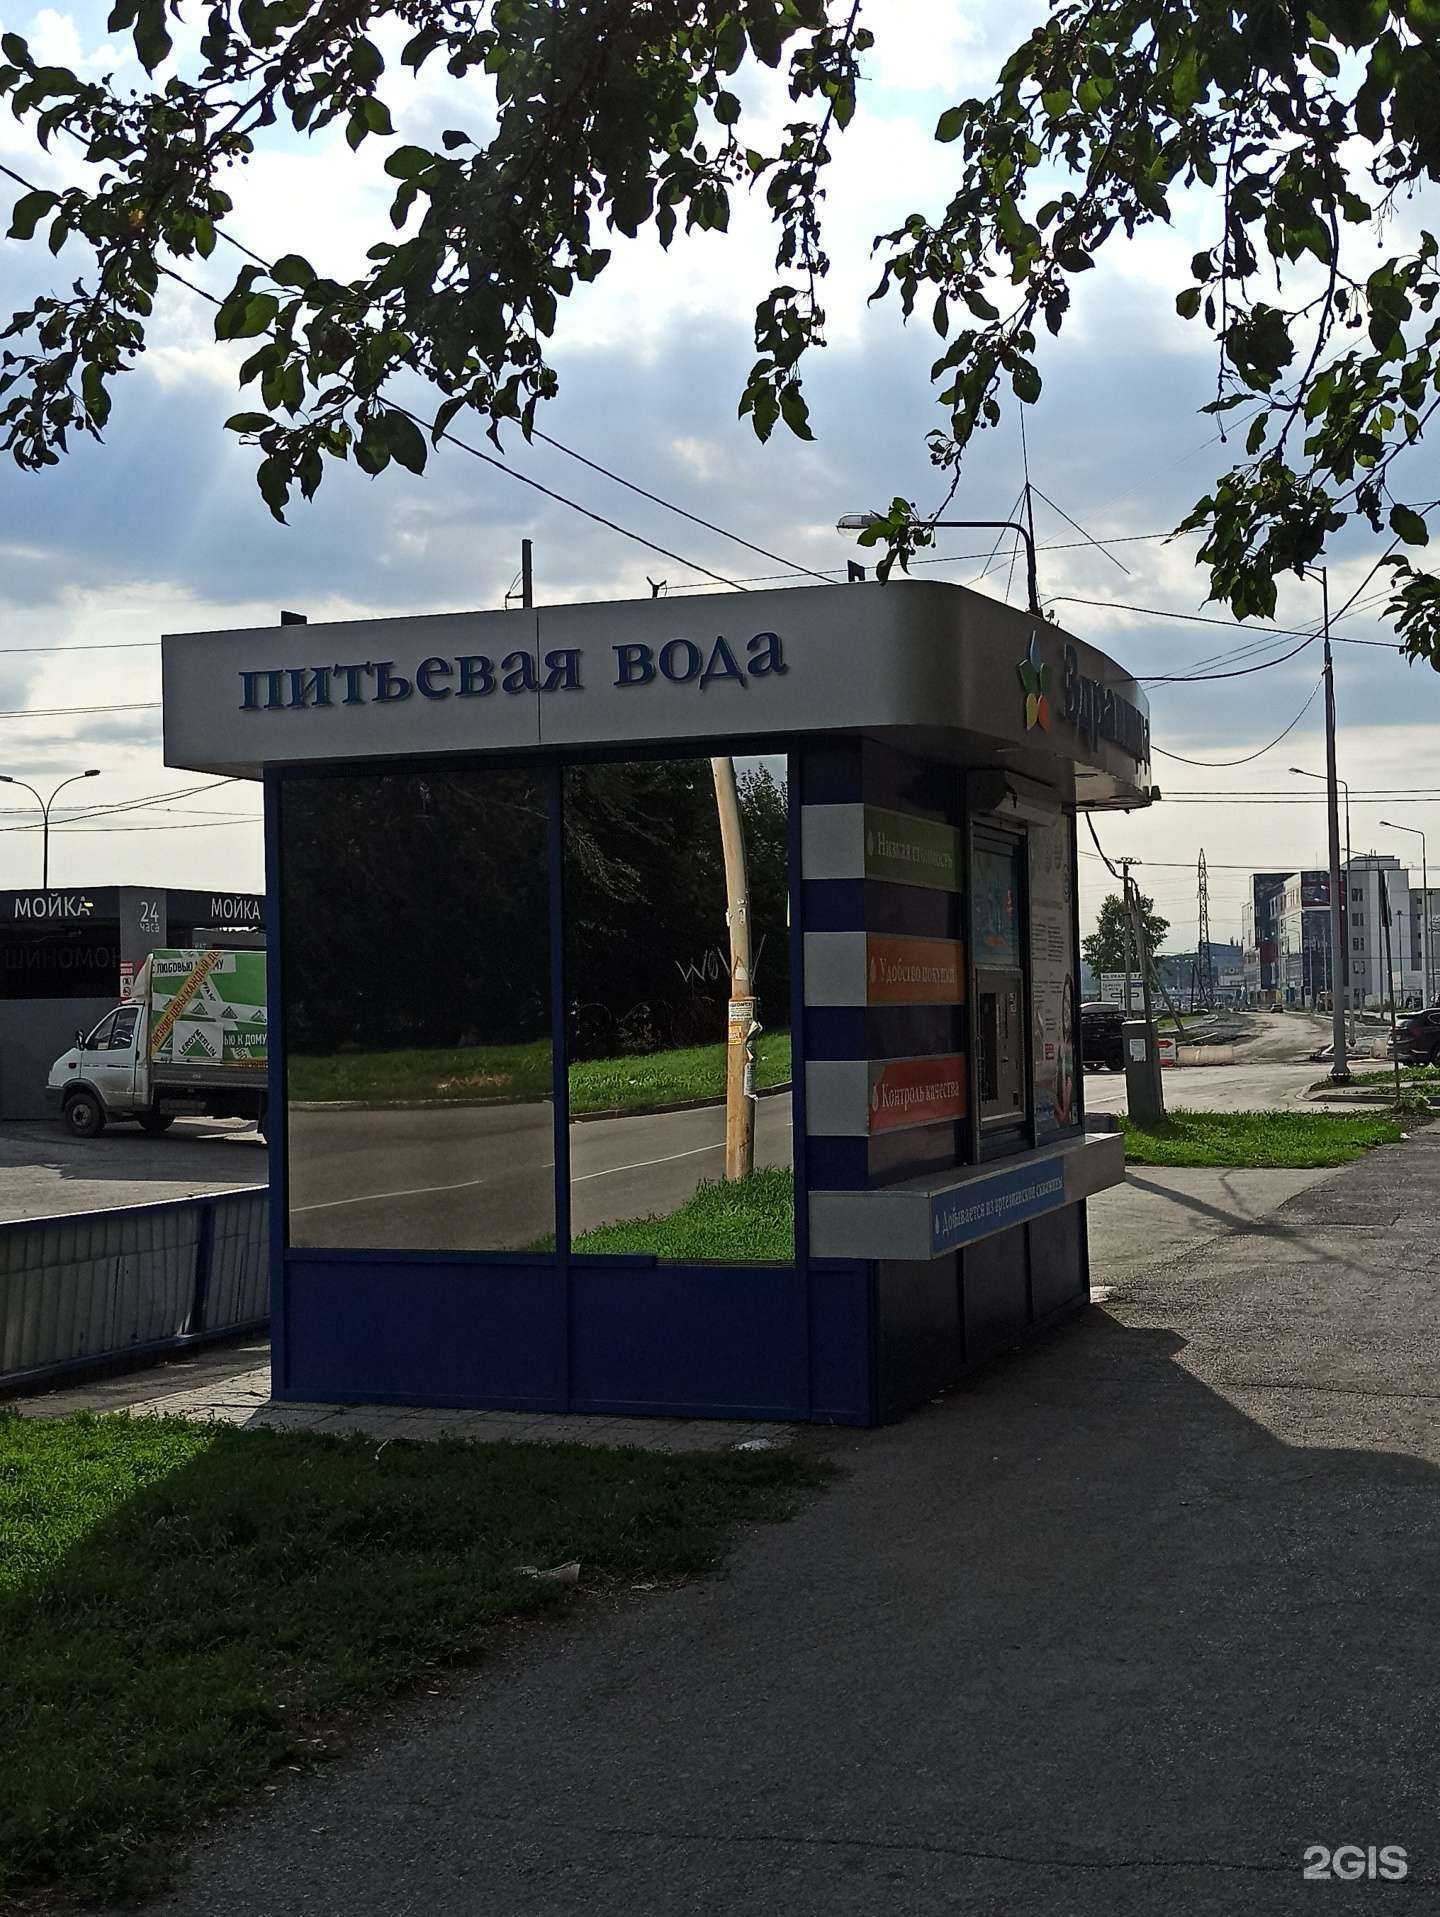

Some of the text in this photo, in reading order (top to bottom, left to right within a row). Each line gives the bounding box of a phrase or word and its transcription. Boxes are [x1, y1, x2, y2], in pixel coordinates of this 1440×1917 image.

[239, 631, 789, 711] питьевая вода
[14, 893, 91, 918] МОЙКА
[140, 901, 160, 923] 24
[211, 896, 261, 920] МОЙКА
[139, 923, 160, 933] часа
[178, 1033, 199, 1055] LEROY
[195, 1028, 218, 1057] MERLIN
[244, 1033, 268, 1047] ДОМУ
[881, 1083, 924, 1112] Контроль
